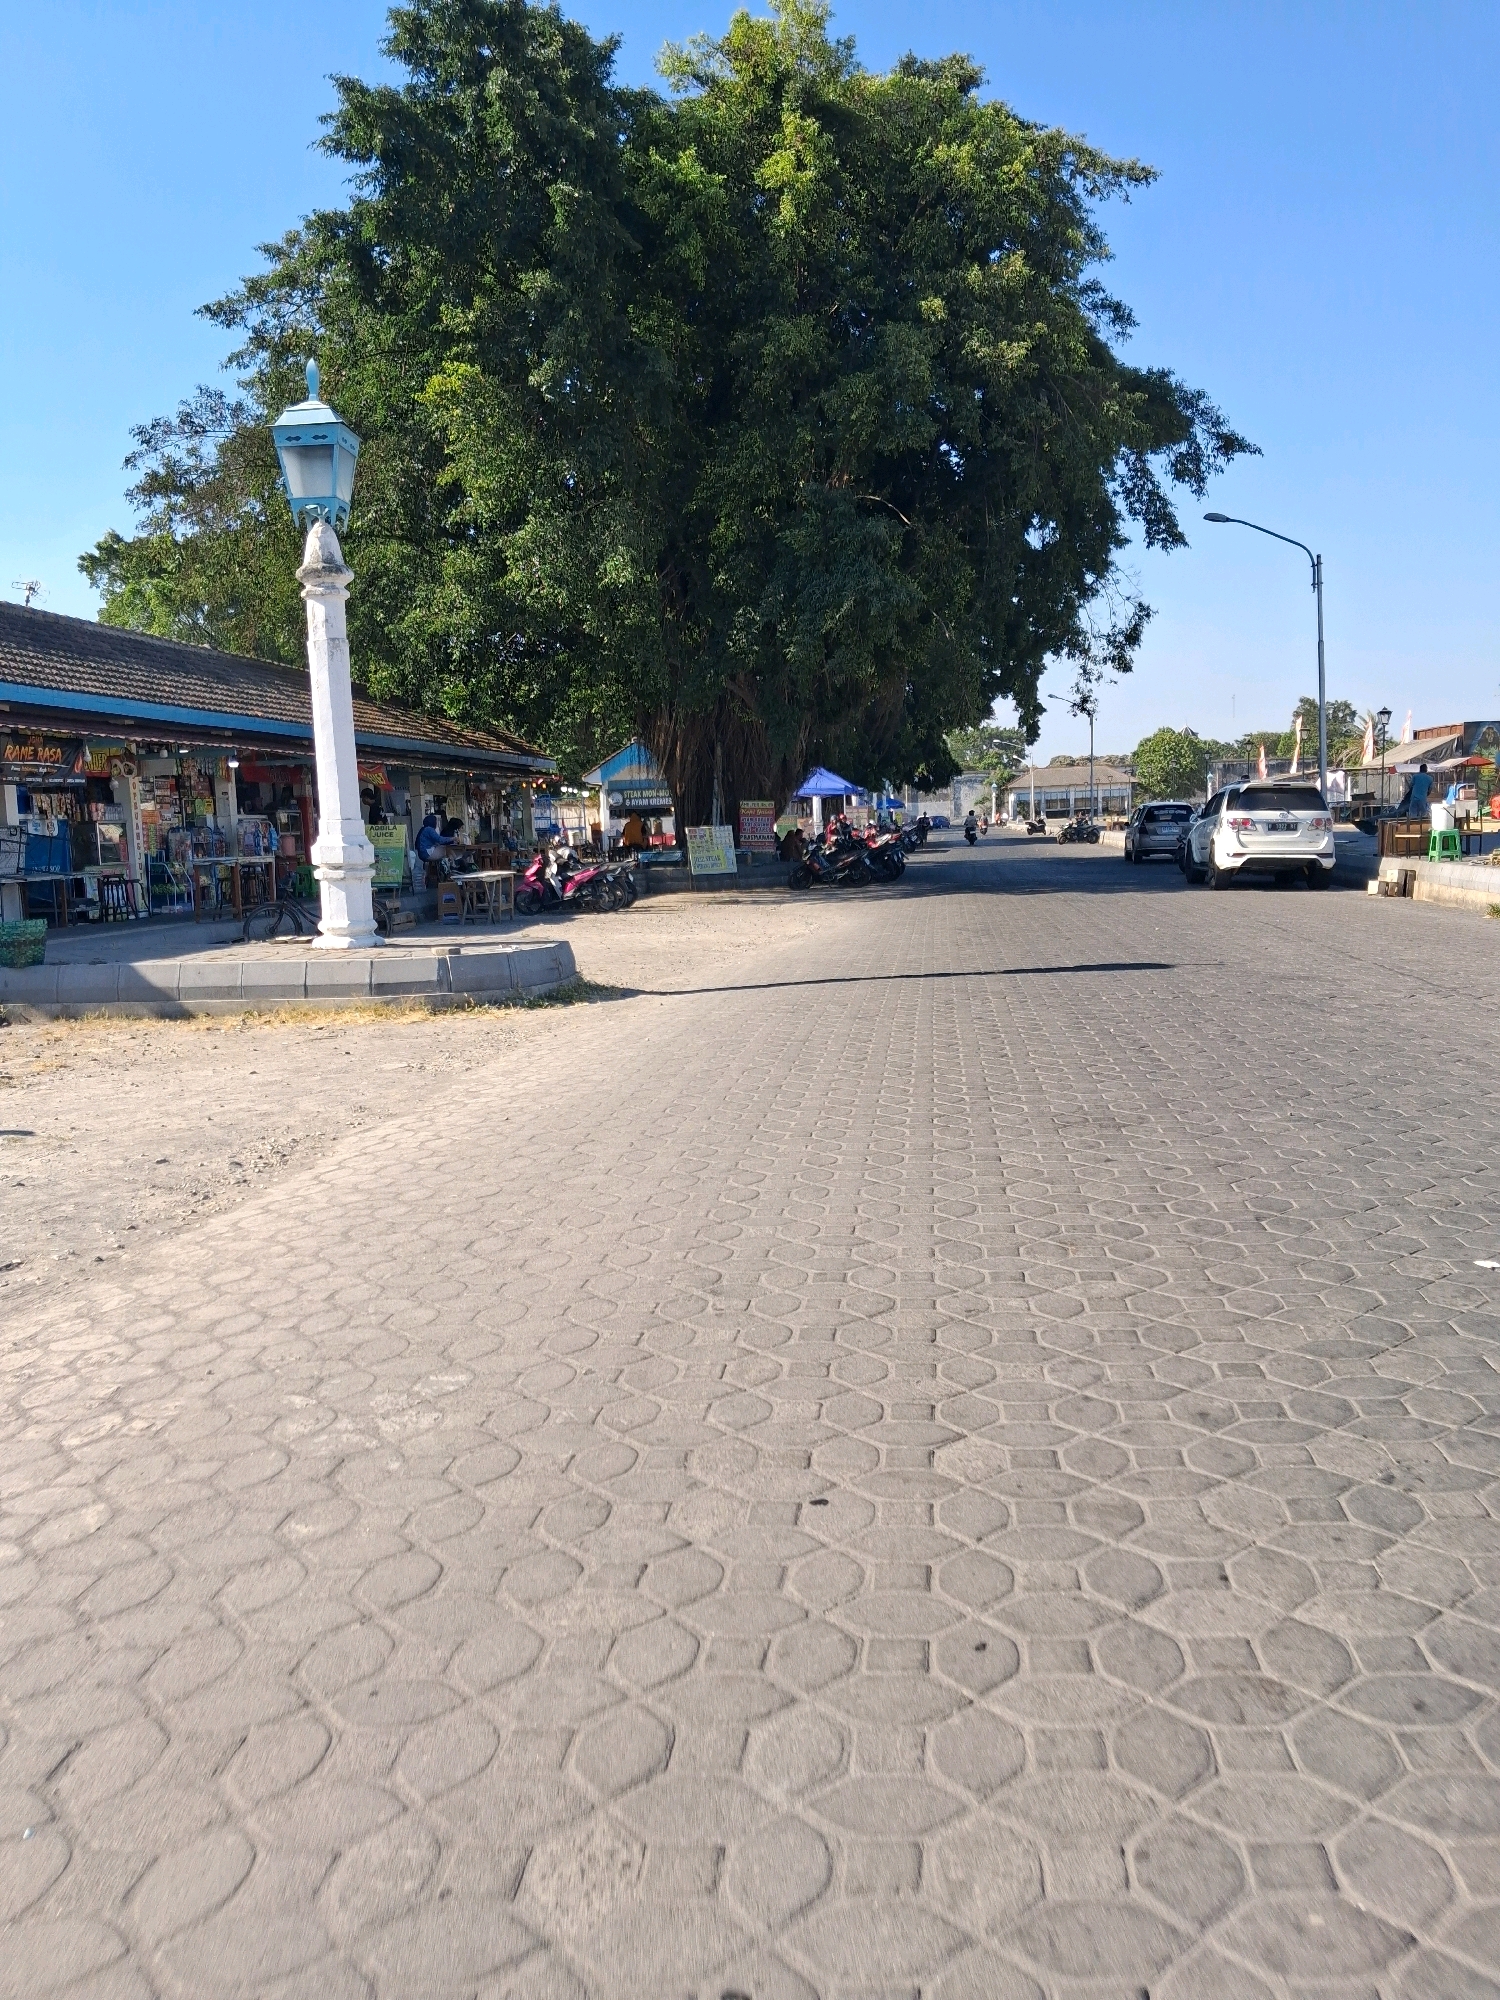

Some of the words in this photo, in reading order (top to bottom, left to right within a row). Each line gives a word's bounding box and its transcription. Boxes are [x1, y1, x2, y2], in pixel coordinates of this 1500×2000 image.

[4, 744, 35, 762] RAME
[37, 747, 63, 764] RASA
[623, 790, 642, 799] STEAK
[631, 798, 649, 806] AYAM
